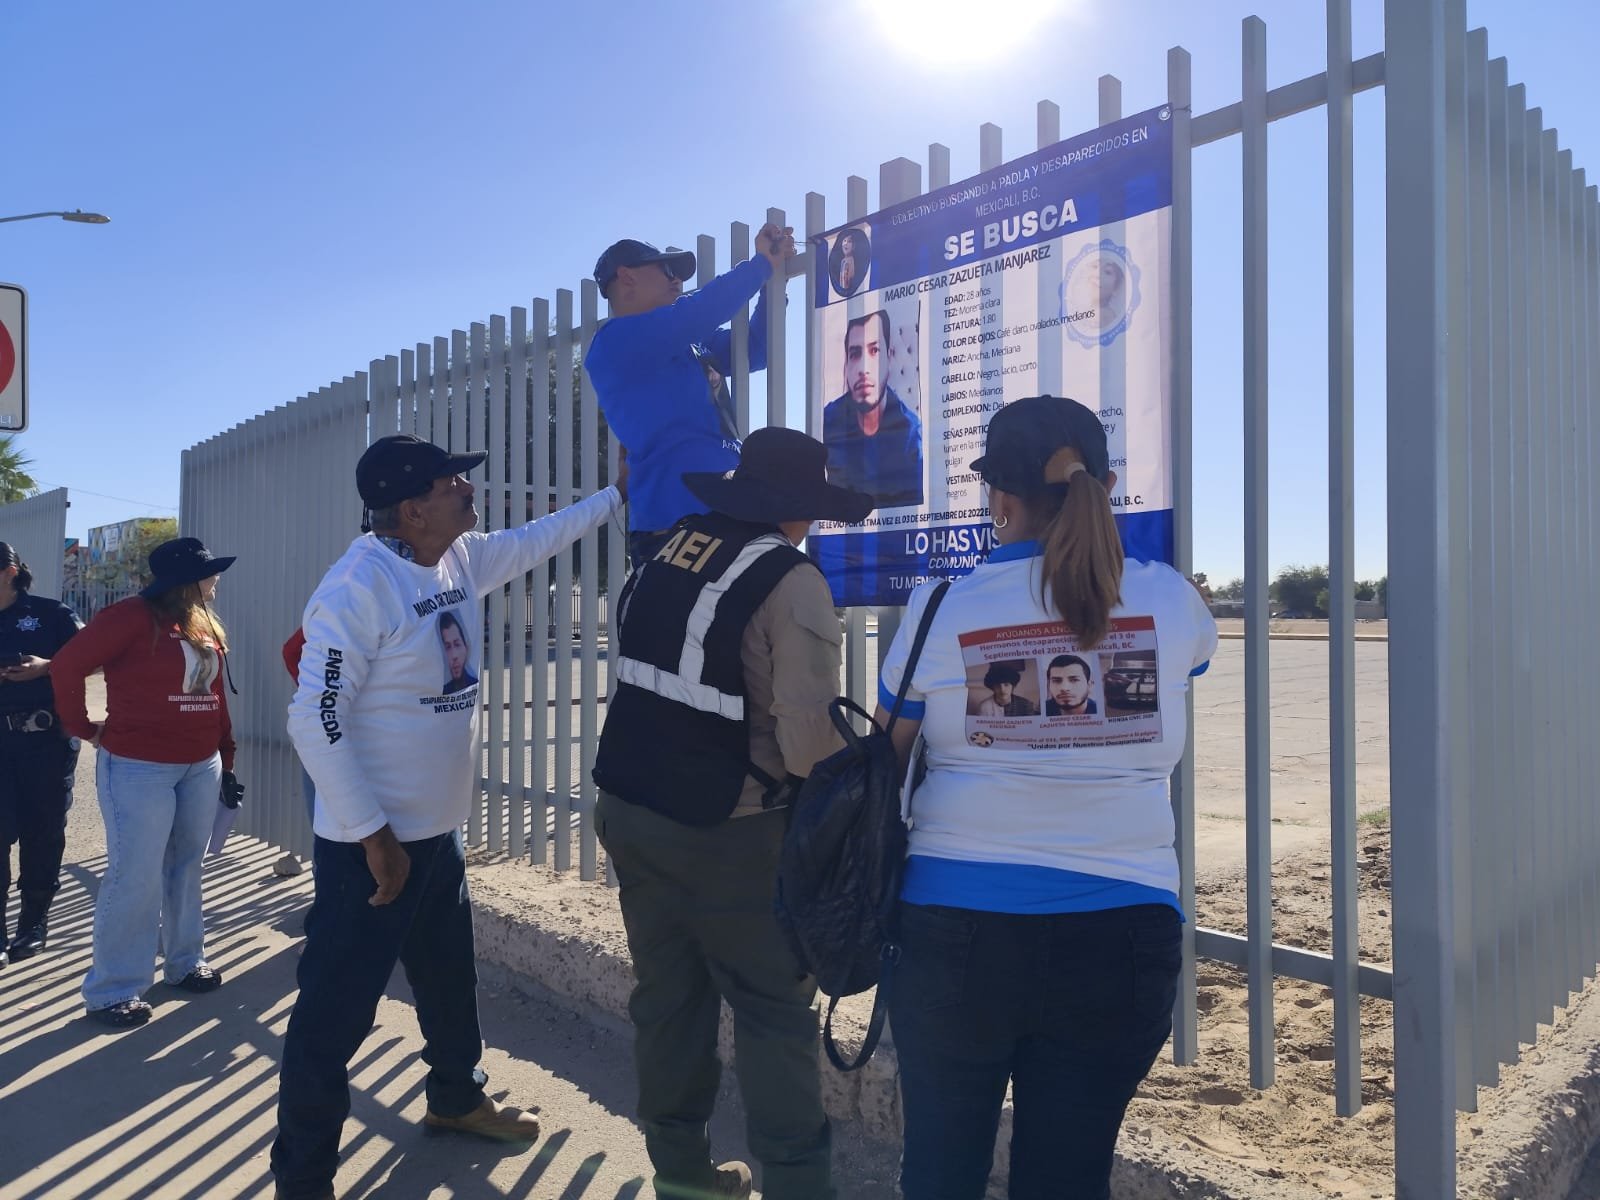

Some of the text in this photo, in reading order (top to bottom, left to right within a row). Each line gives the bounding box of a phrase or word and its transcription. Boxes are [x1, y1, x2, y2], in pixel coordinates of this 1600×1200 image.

[940, 183, 989, 210] BUSCANDO
[990, 180, 997, 192] A
[1032, 164, 1039, 177] Y
[1041, 133, 1129, 174] DESAPARECIDOS
[1132, 125, 1148, 143] EN
[975, 186, 1041, 218] MEXICALI, B.C.
[944, 198, 1078, 261] SE BUSCA
[885, 244, 1051, 303] MARIO CESAR ZAZUETA MANJAREZ
[944, 287, 991, 306] EDAD: 28 años
[943, 297, 1001, 319] TEZ: Morena clara
[943, 313, 997, 333] ESTATURA: 1.80
[943, 337, 967, 349] COLOR
[967, 335, 977, 345] DE
[997, 327, 1011, 338] Café
[1029, 317, 1060, 331] ovalados,
[1060, 309, 1095, 325] medianos
[942, 344, 1021, 366] NARIZ: Ancha, Mediana
[941, 371, 975, 385] CABELLO:
[1019, 361, 1037, 372] corto
[941, 387, 1003, 403] LABIOS: Medianos
[942, 402, 991, 419] COMPLEXION:
[943, 428, 963, 441] SEÑAS
[1094, 406, 1123, 417] erecho,
[943, 442, 959, 454] lunar
[959, 442, 967, 451] en
[968, 440, 974, 449] la
[946, 489, 968, 500] negros
[880, 516, 893, 525] VEZ
[894, 516, 902, 524] EL
[903, 515, 910, 523] 03
[911, 514, 918, 523] DE
[919, 510, 958, 522] SEPTIEMBRE
[958, 509, 967, 518] DE
[968, 507, 984, 518] 2022
[1124, 495, 1133, 506] B.
[1134, 495, 1144, 505] C.
[652, 529, 723, 574] AEI
[905, 532, 928, 555] LO
[932, 528, 970, 553] HAS
[889, 576, 903, 589] TU
[980, 640, 1020, 652] Hermanos
[984, 649, 1030, 660] Septiembre
[1032, 647, 1044, 655] del
[1058, 742, 1070, 750] por
